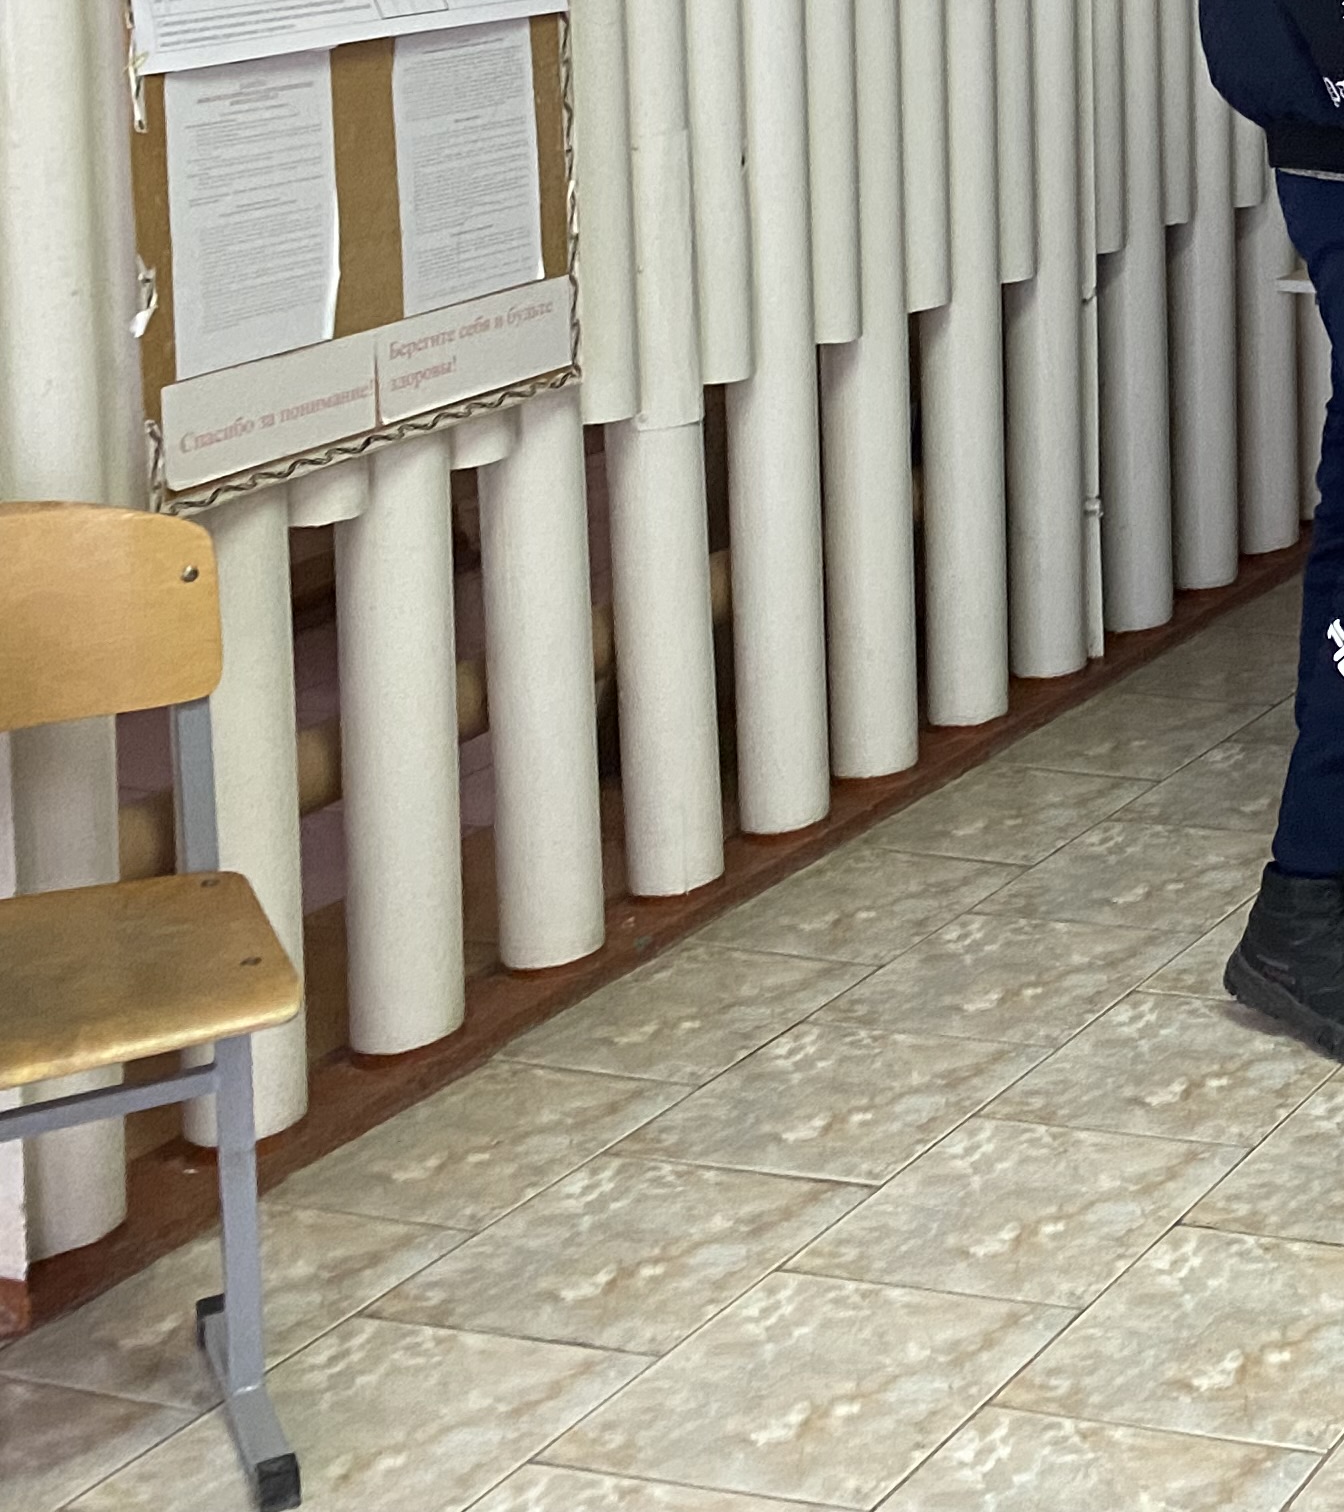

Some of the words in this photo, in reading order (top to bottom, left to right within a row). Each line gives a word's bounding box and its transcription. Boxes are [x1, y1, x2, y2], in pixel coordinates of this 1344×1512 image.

[389, 329, 456, 361] Берегите
[458, 315, 491, 339] себя
[494, 315, 505, 329] и
[179, 416, 255, 454] Спасибо
[260, 413, 276, 429] за
[280, 379, 374, 423] понимание!
